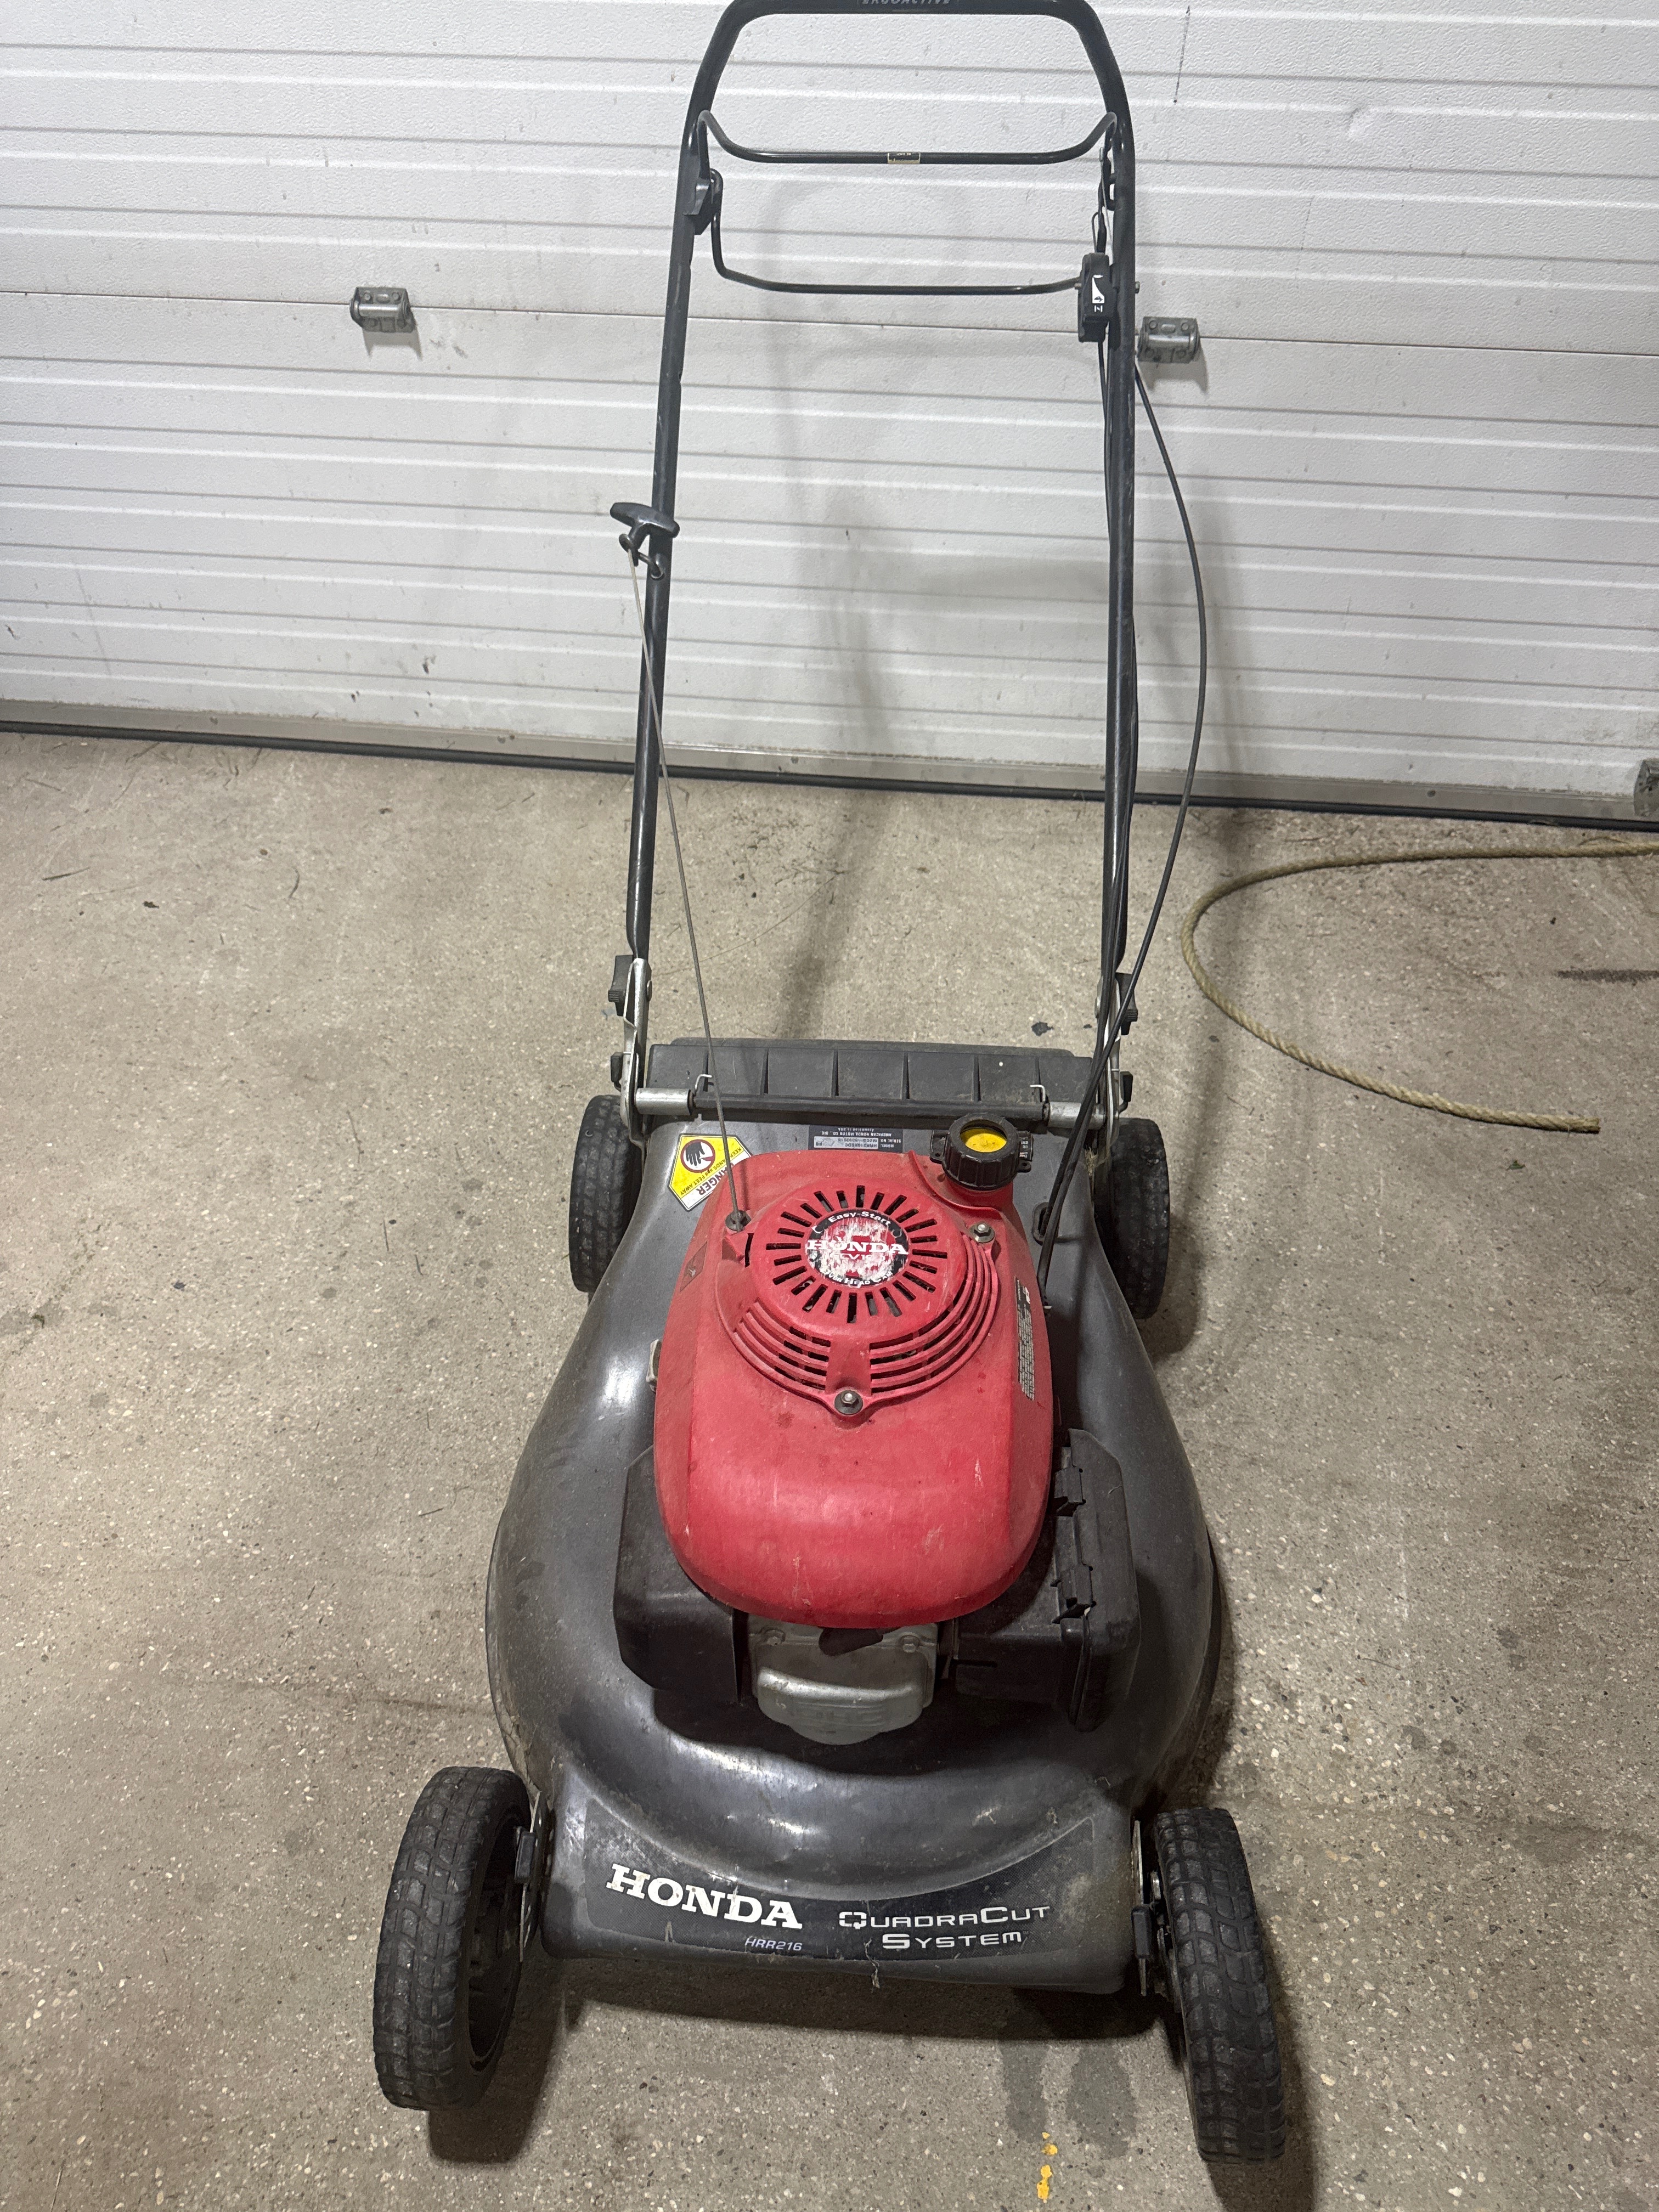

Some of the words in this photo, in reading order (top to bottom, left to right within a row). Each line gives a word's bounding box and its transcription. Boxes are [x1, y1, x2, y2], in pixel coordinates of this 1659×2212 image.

[713, 1159, 726, 1170] ANDS
[704, 1169, 713, 1177] and
[693, 1175, 706, 1184] FEET
[680, 1183, 693, 1195] AWAY
[827, 1211, 891, 1226] Easy-Start
[806, 1239, 909, 1255] HONDA
[606, 1863, 803, 1929] HONDA
[744, 1938, 803, 1951] HRR216
